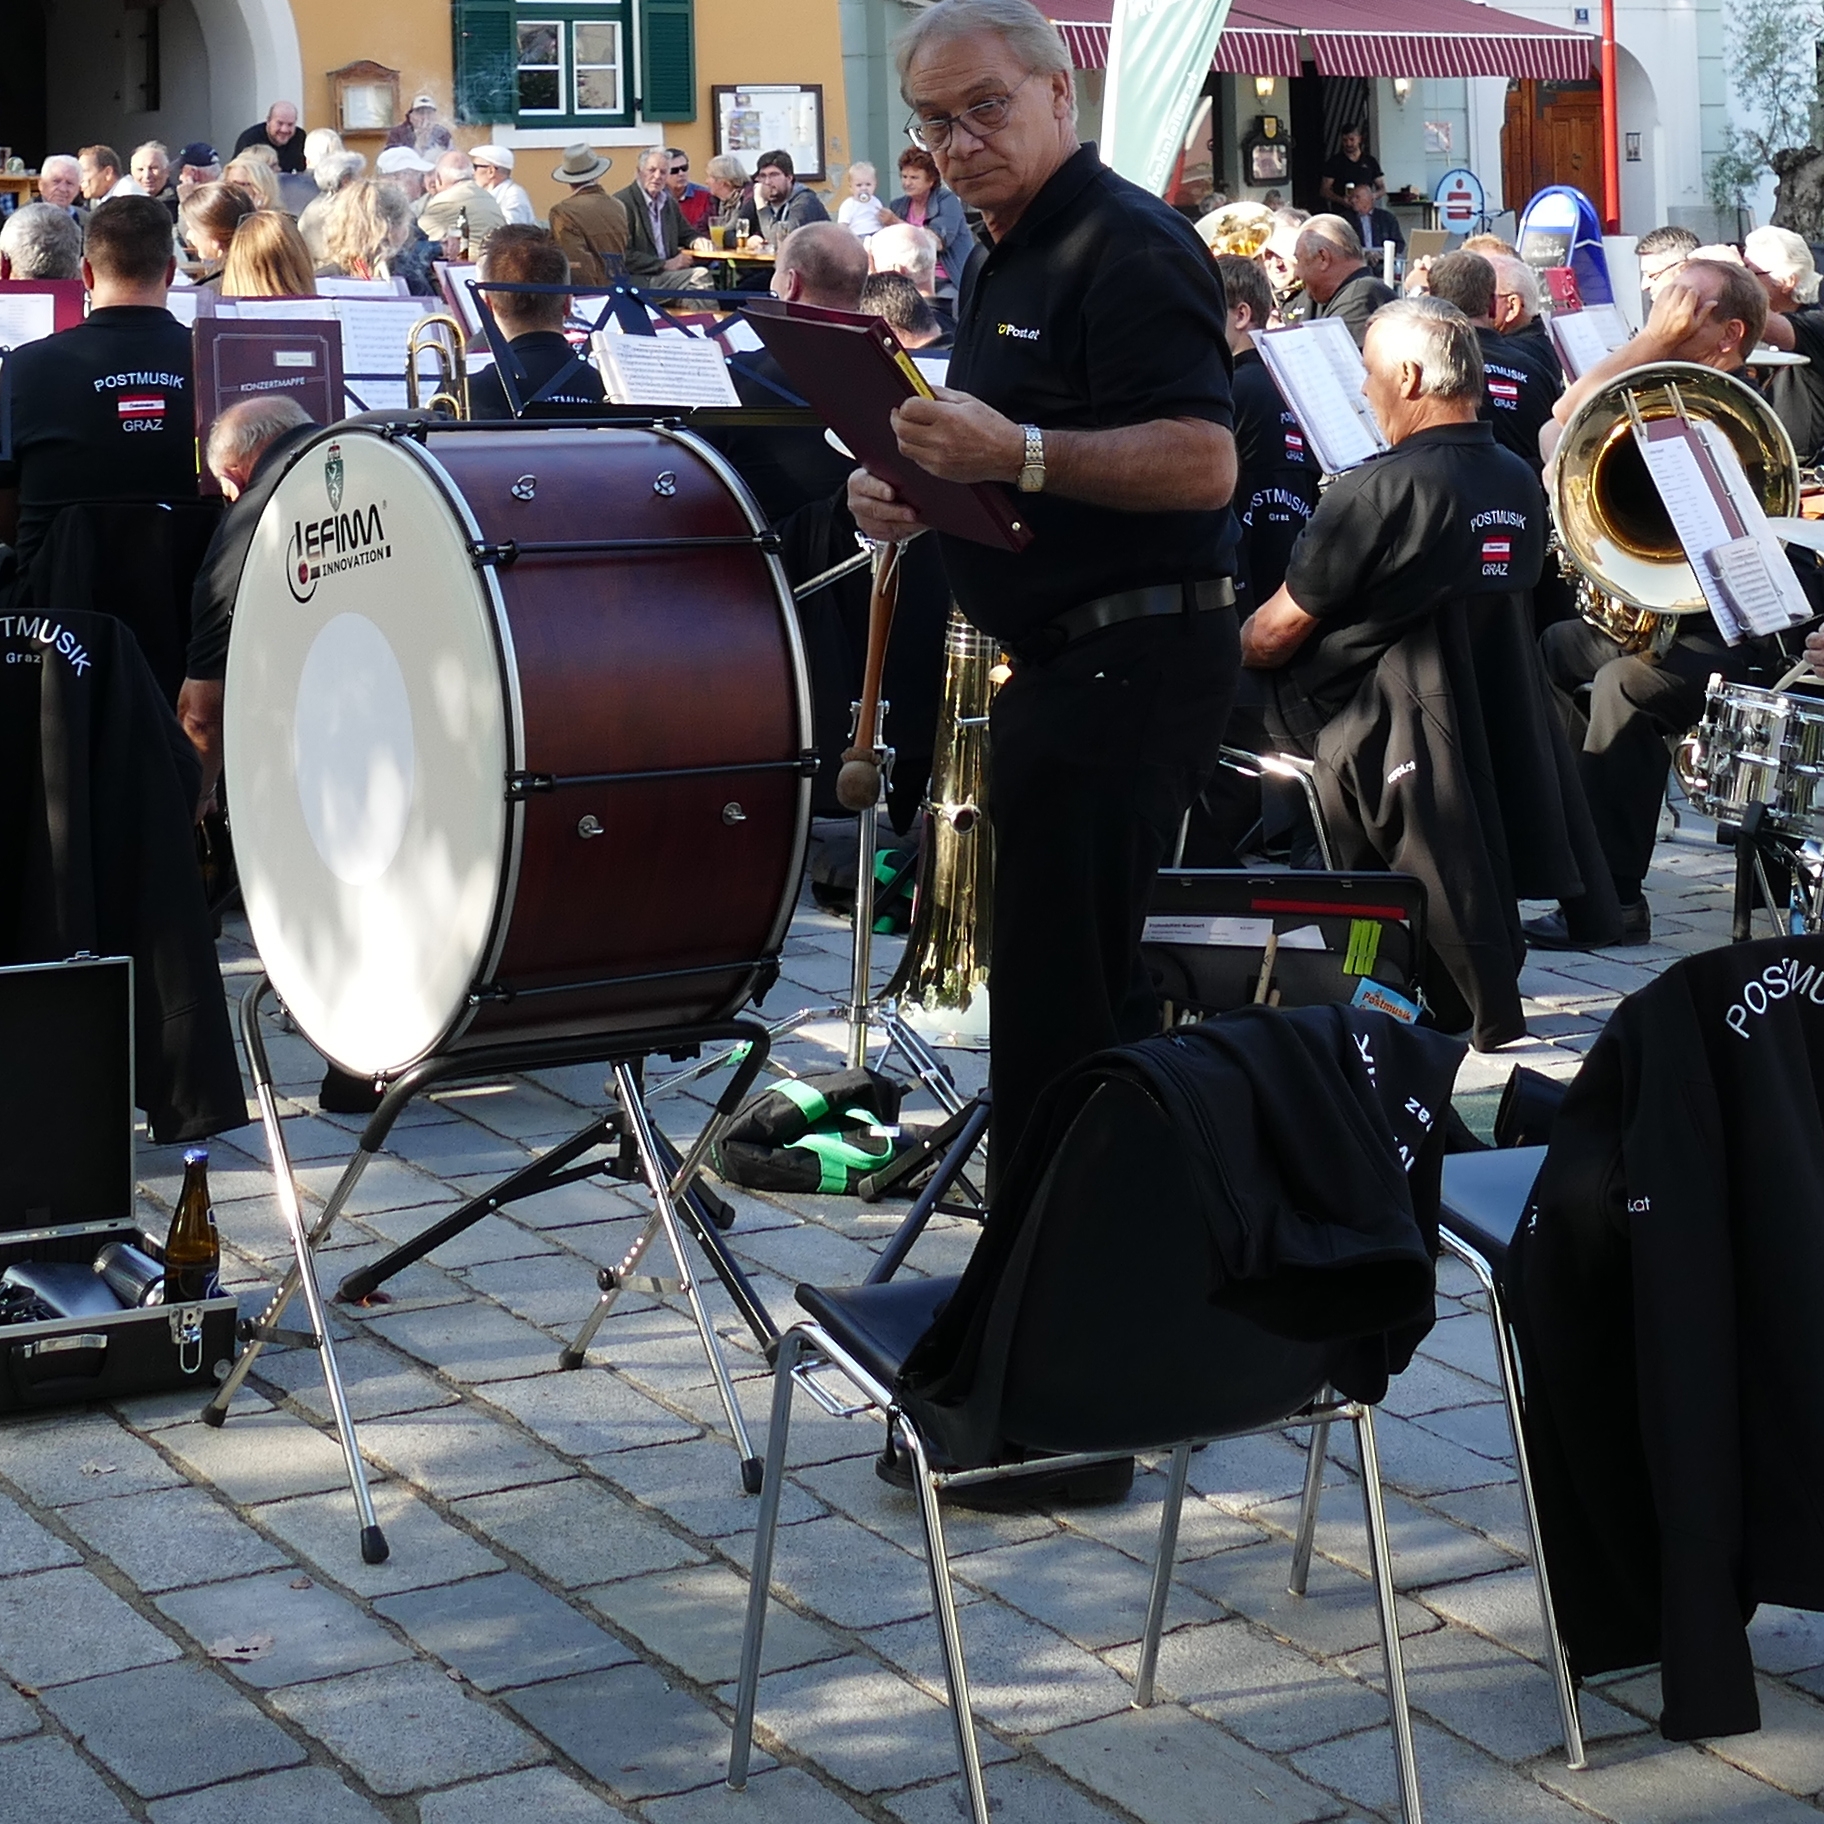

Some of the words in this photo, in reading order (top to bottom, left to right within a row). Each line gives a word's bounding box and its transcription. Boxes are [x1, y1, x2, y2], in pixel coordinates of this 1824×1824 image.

[1484, 363, 1527, 383] STMUSIK
[94, 372, 185, 393] POSTMUSIK
[240, 376, 306, 392] KONZERTMAPPE
[1494, 398, 1518, 411] GRAZ
[122, 419, 164, 433] GRAZ
[1268, 512, 1289, 522] Graz
[1470, 509, 1527, 532] POSTMUSIK
[323, 549, 384, 577] INNOVATION
[1482, 562, 1509, 576] GRAZ
[6, 653, 41, 664] Graz
[1363, 991, 1412, 1022] Postmusik
